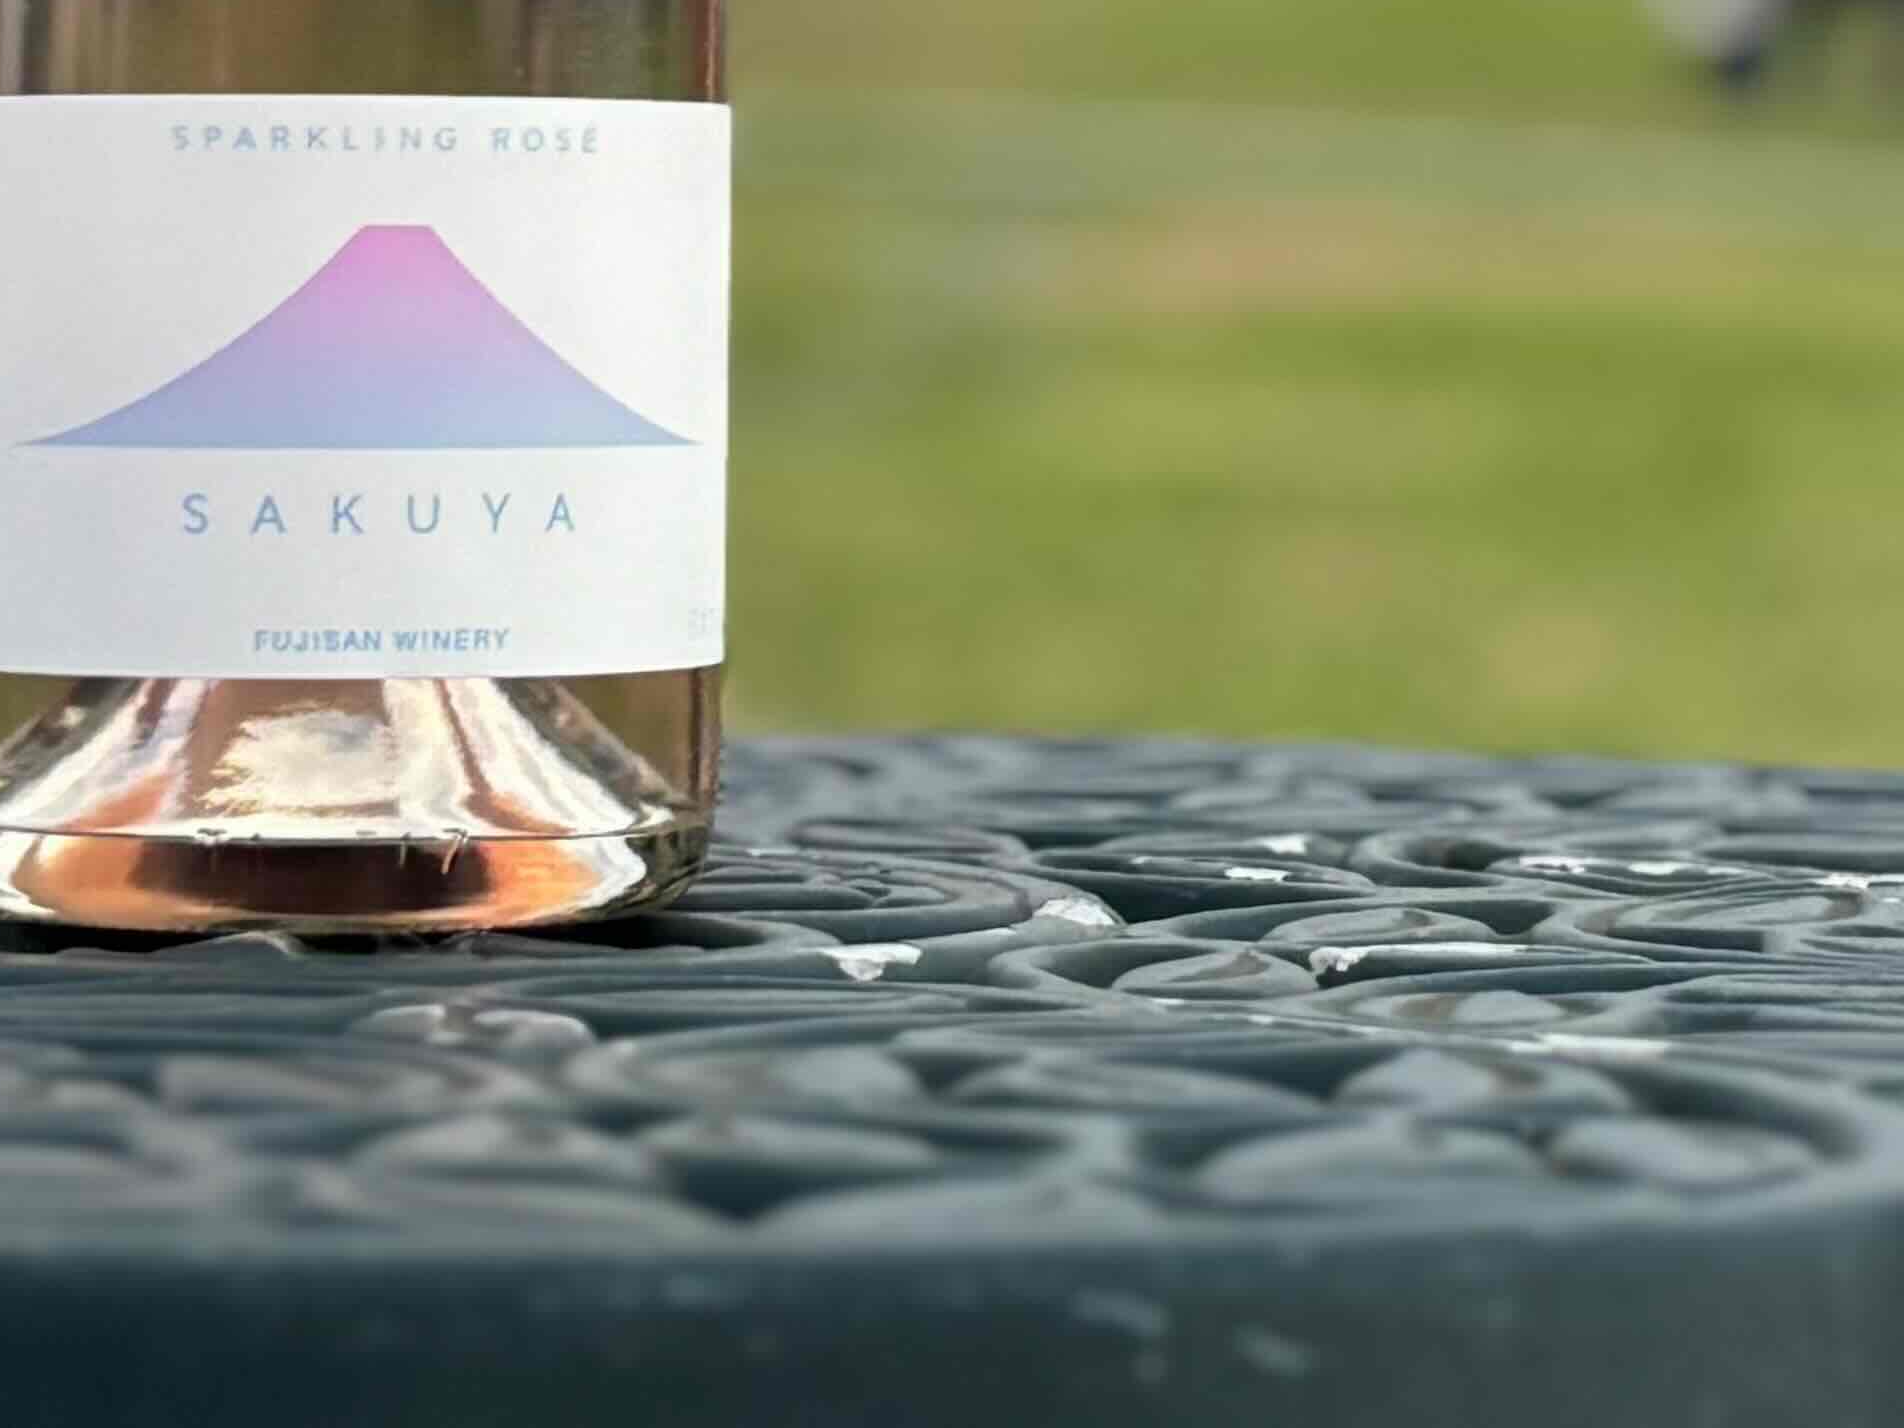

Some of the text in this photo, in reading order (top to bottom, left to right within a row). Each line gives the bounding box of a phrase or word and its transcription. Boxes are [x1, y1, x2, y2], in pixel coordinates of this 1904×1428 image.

[169, 121, 600, 153] SPARKLING ROSÉ
[181, 491, 577, 535] SAKUYA
[253, 628, 512, 654] FUJISAN WINERY
